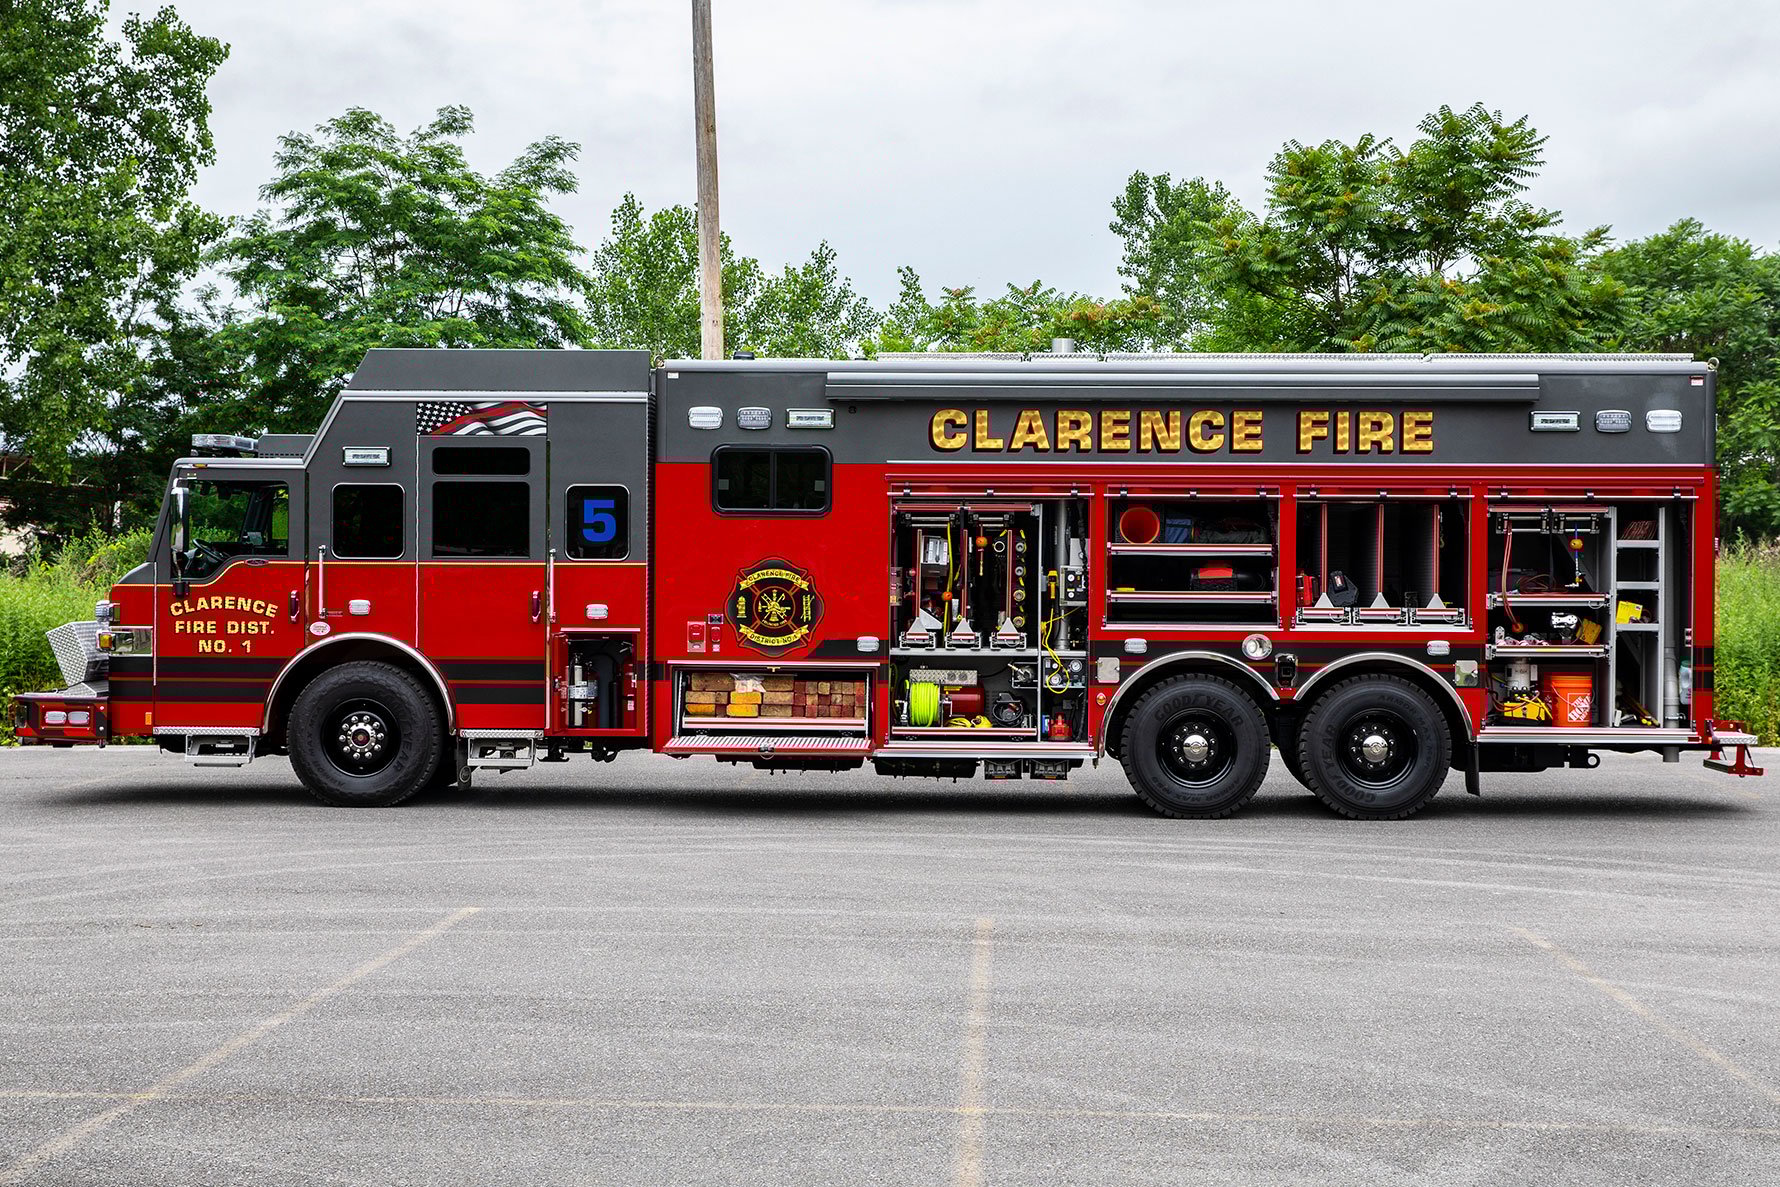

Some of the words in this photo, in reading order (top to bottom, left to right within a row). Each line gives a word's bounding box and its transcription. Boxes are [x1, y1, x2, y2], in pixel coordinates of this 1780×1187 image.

[928, 409, 1264, 454] CLARENCE
[1296, 410, 1435, 454] FIRE
[582, 499, 617, 543] 5
[748, 570, 783, 581] CLARENCE
[785, 572, 801, 583] FIRE
[169, 596, 279, 618] CLARENCE
[175, 620, 217, 634] FIRE
[226, 620, 275, 635] DIST.
[198, 639, 233, 653] NO.
[241, 639, 251, 653] 1
[749, 633, 780, 645] DISTRICT
